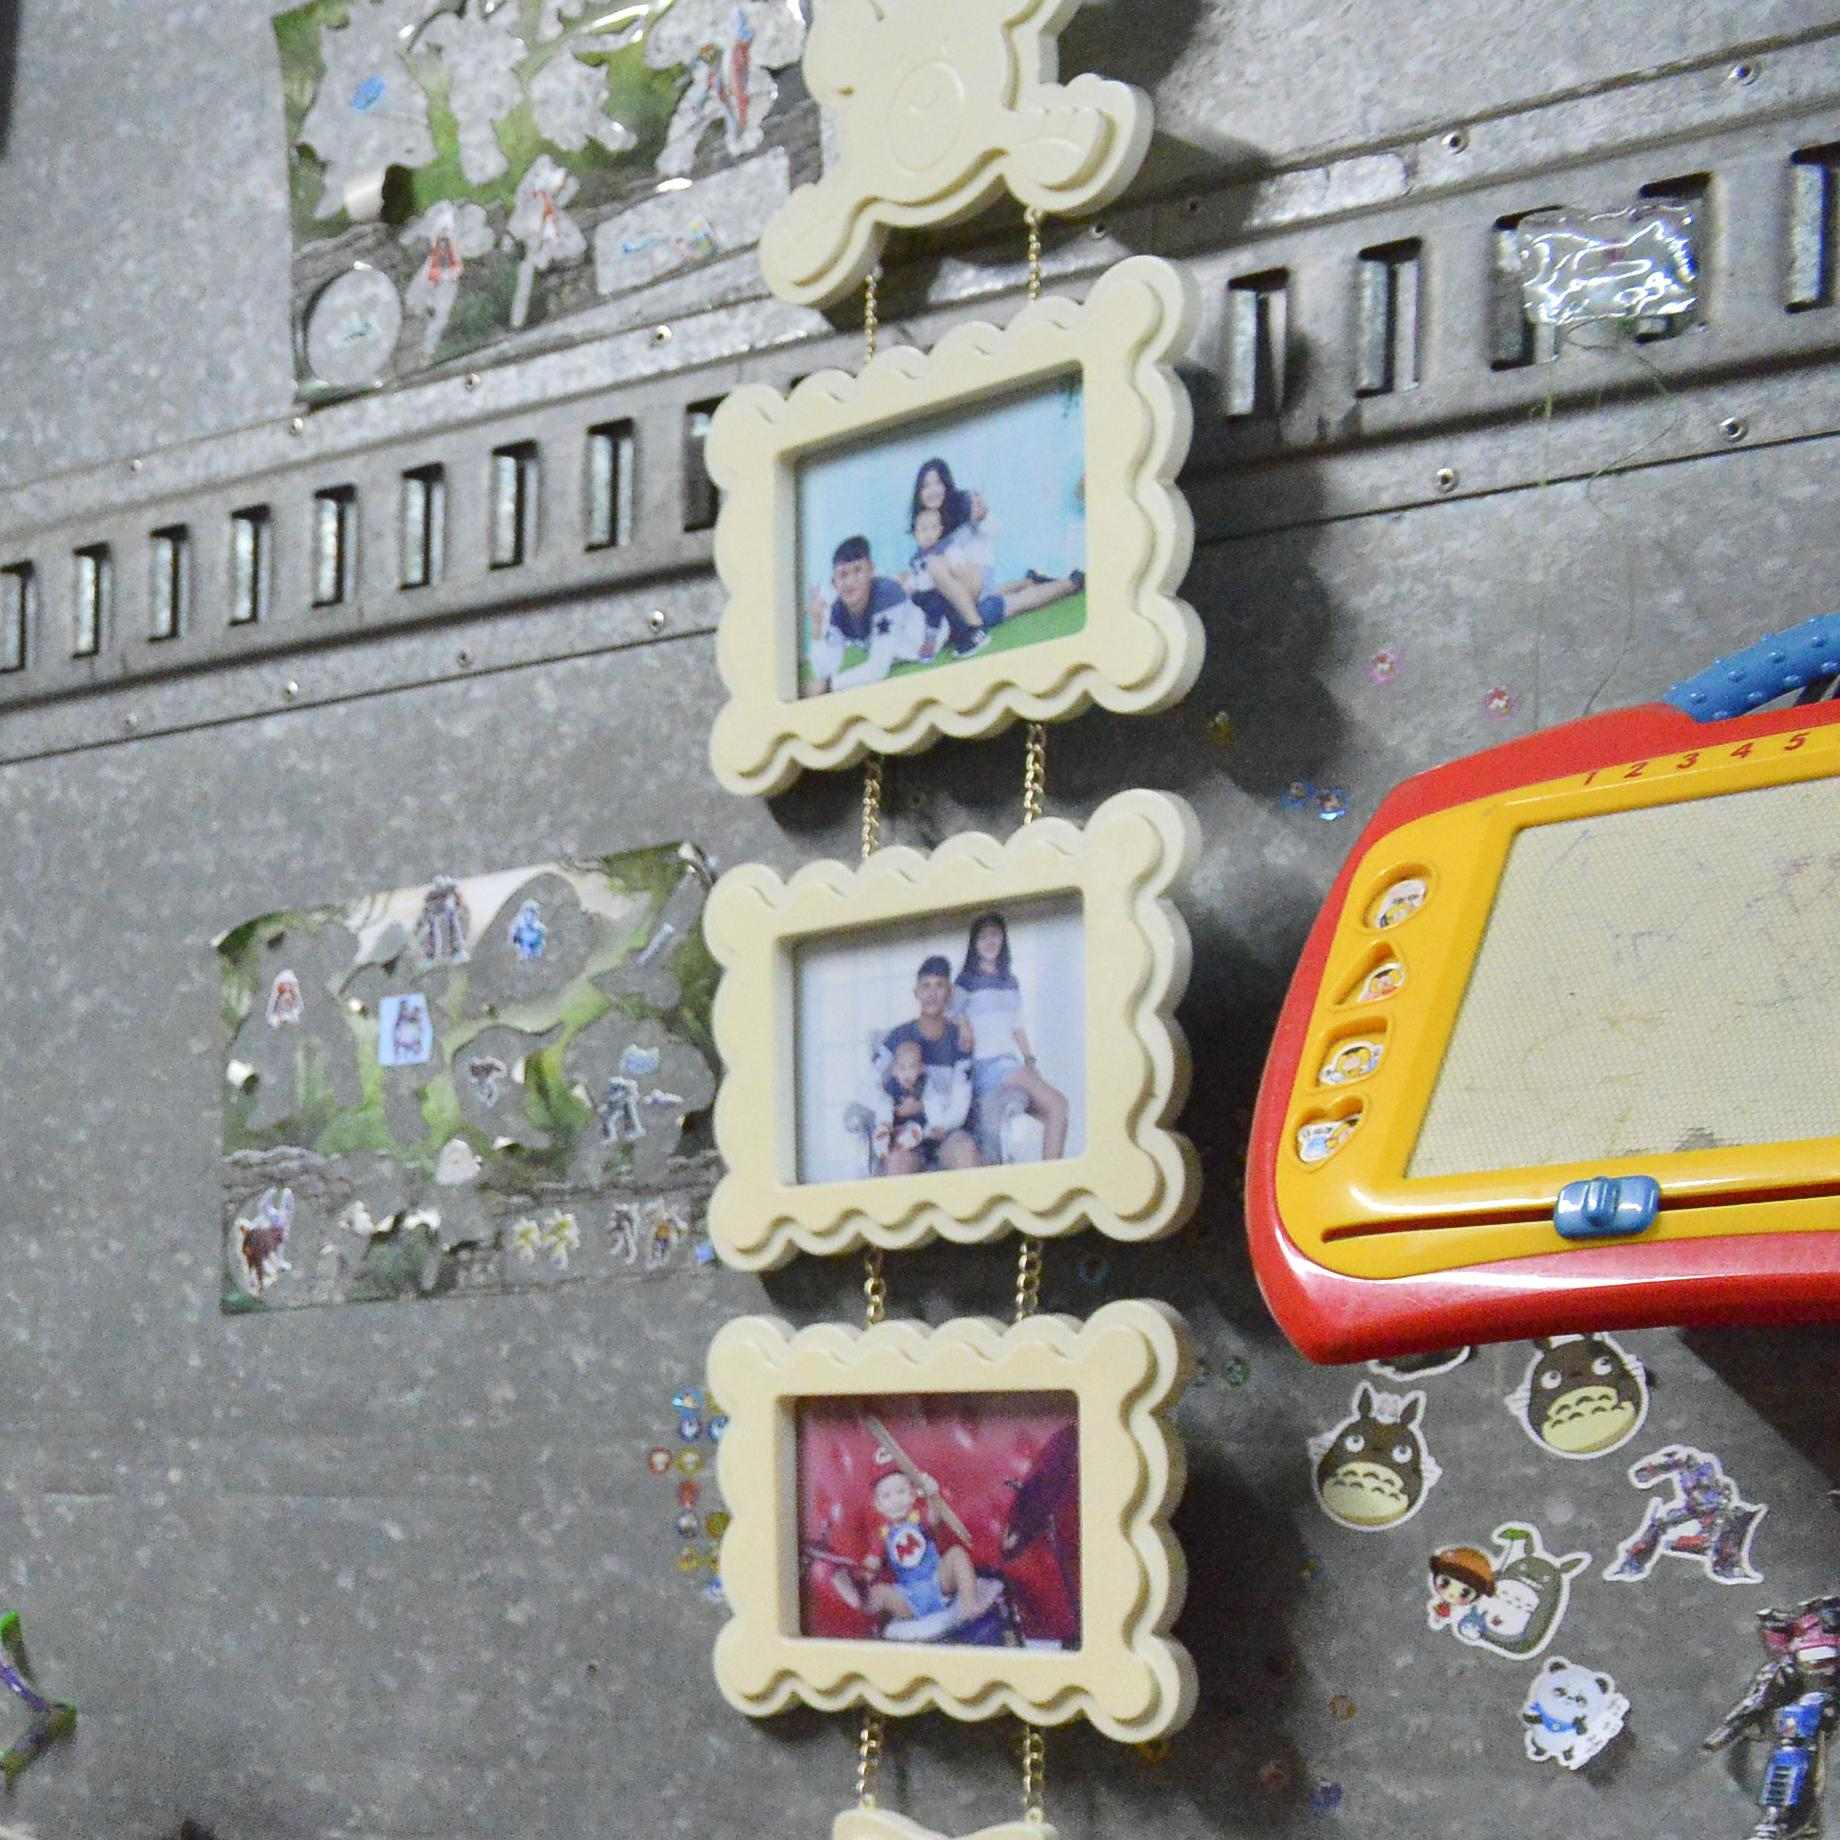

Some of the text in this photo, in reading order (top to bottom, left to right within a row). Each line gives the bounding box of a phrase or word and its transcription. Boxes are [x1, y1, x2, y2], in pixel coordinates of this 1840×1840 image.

[1583, 732, 1809, 786] 1 2 3 4 5
